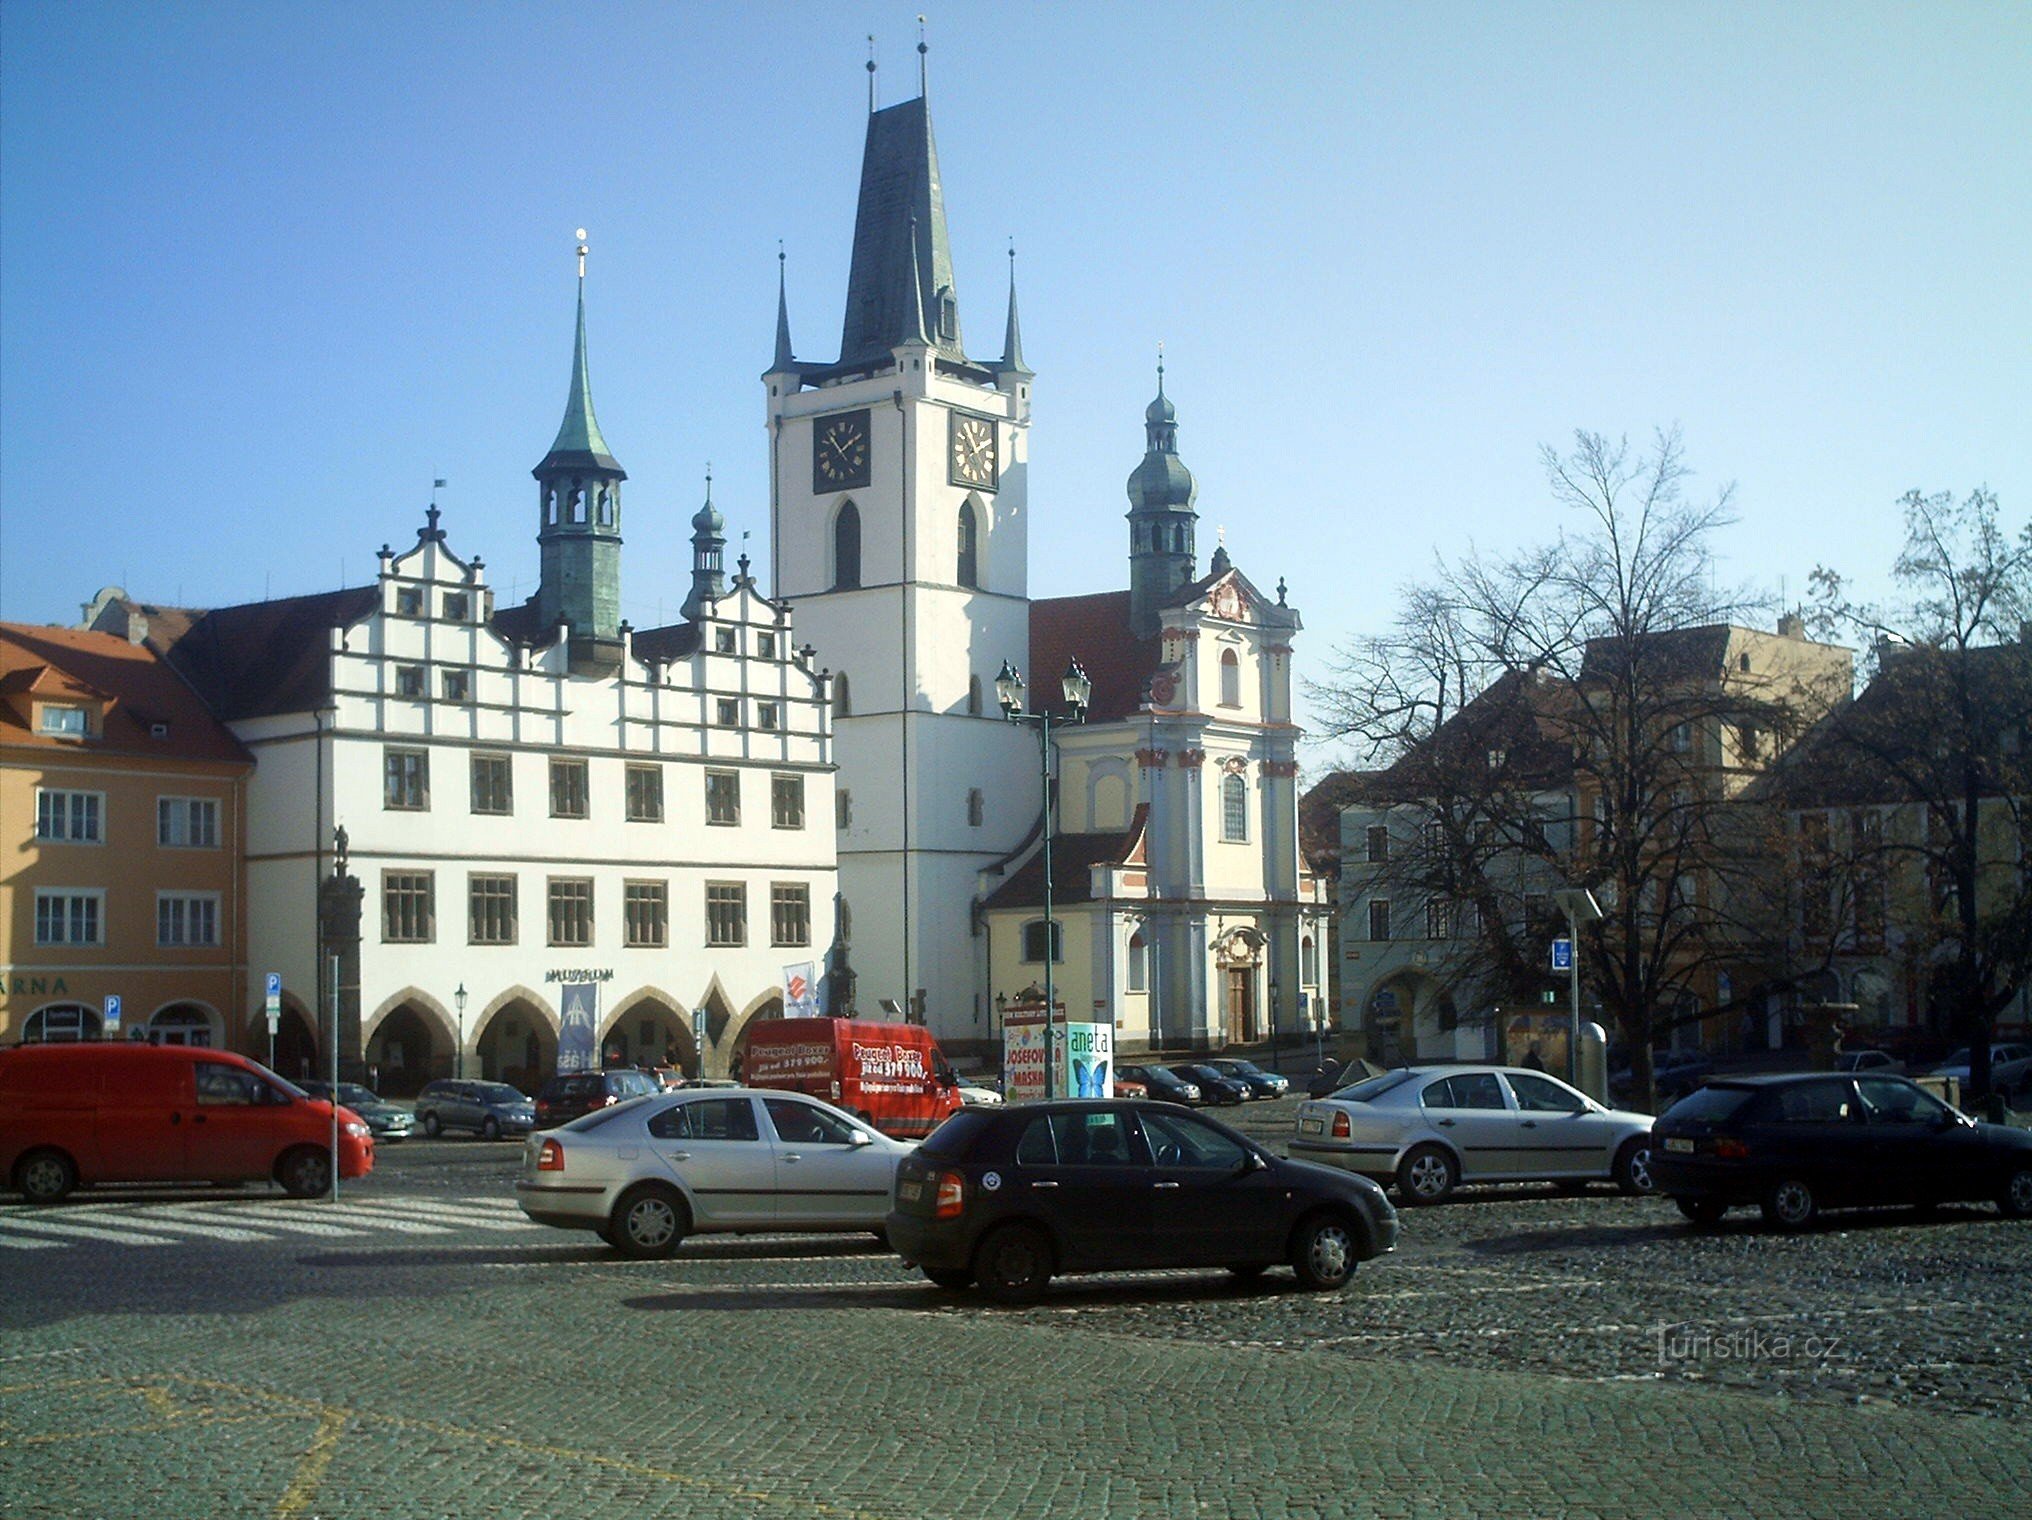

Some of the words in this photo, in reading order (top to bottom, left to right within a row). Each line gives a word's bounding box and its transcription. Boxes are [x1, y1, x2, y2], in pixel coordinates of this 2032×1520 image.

[107, 998, 118, 1014] P
[1071, 1025, 1109, 1053] aneta
[751, 1045, 797, 1058] Peugeot
[797, 1043, 832, 1056] Boxer
[852, 1042, 893, 1063] Peugeot
[895, 1045, 923, 1063] Boxer
